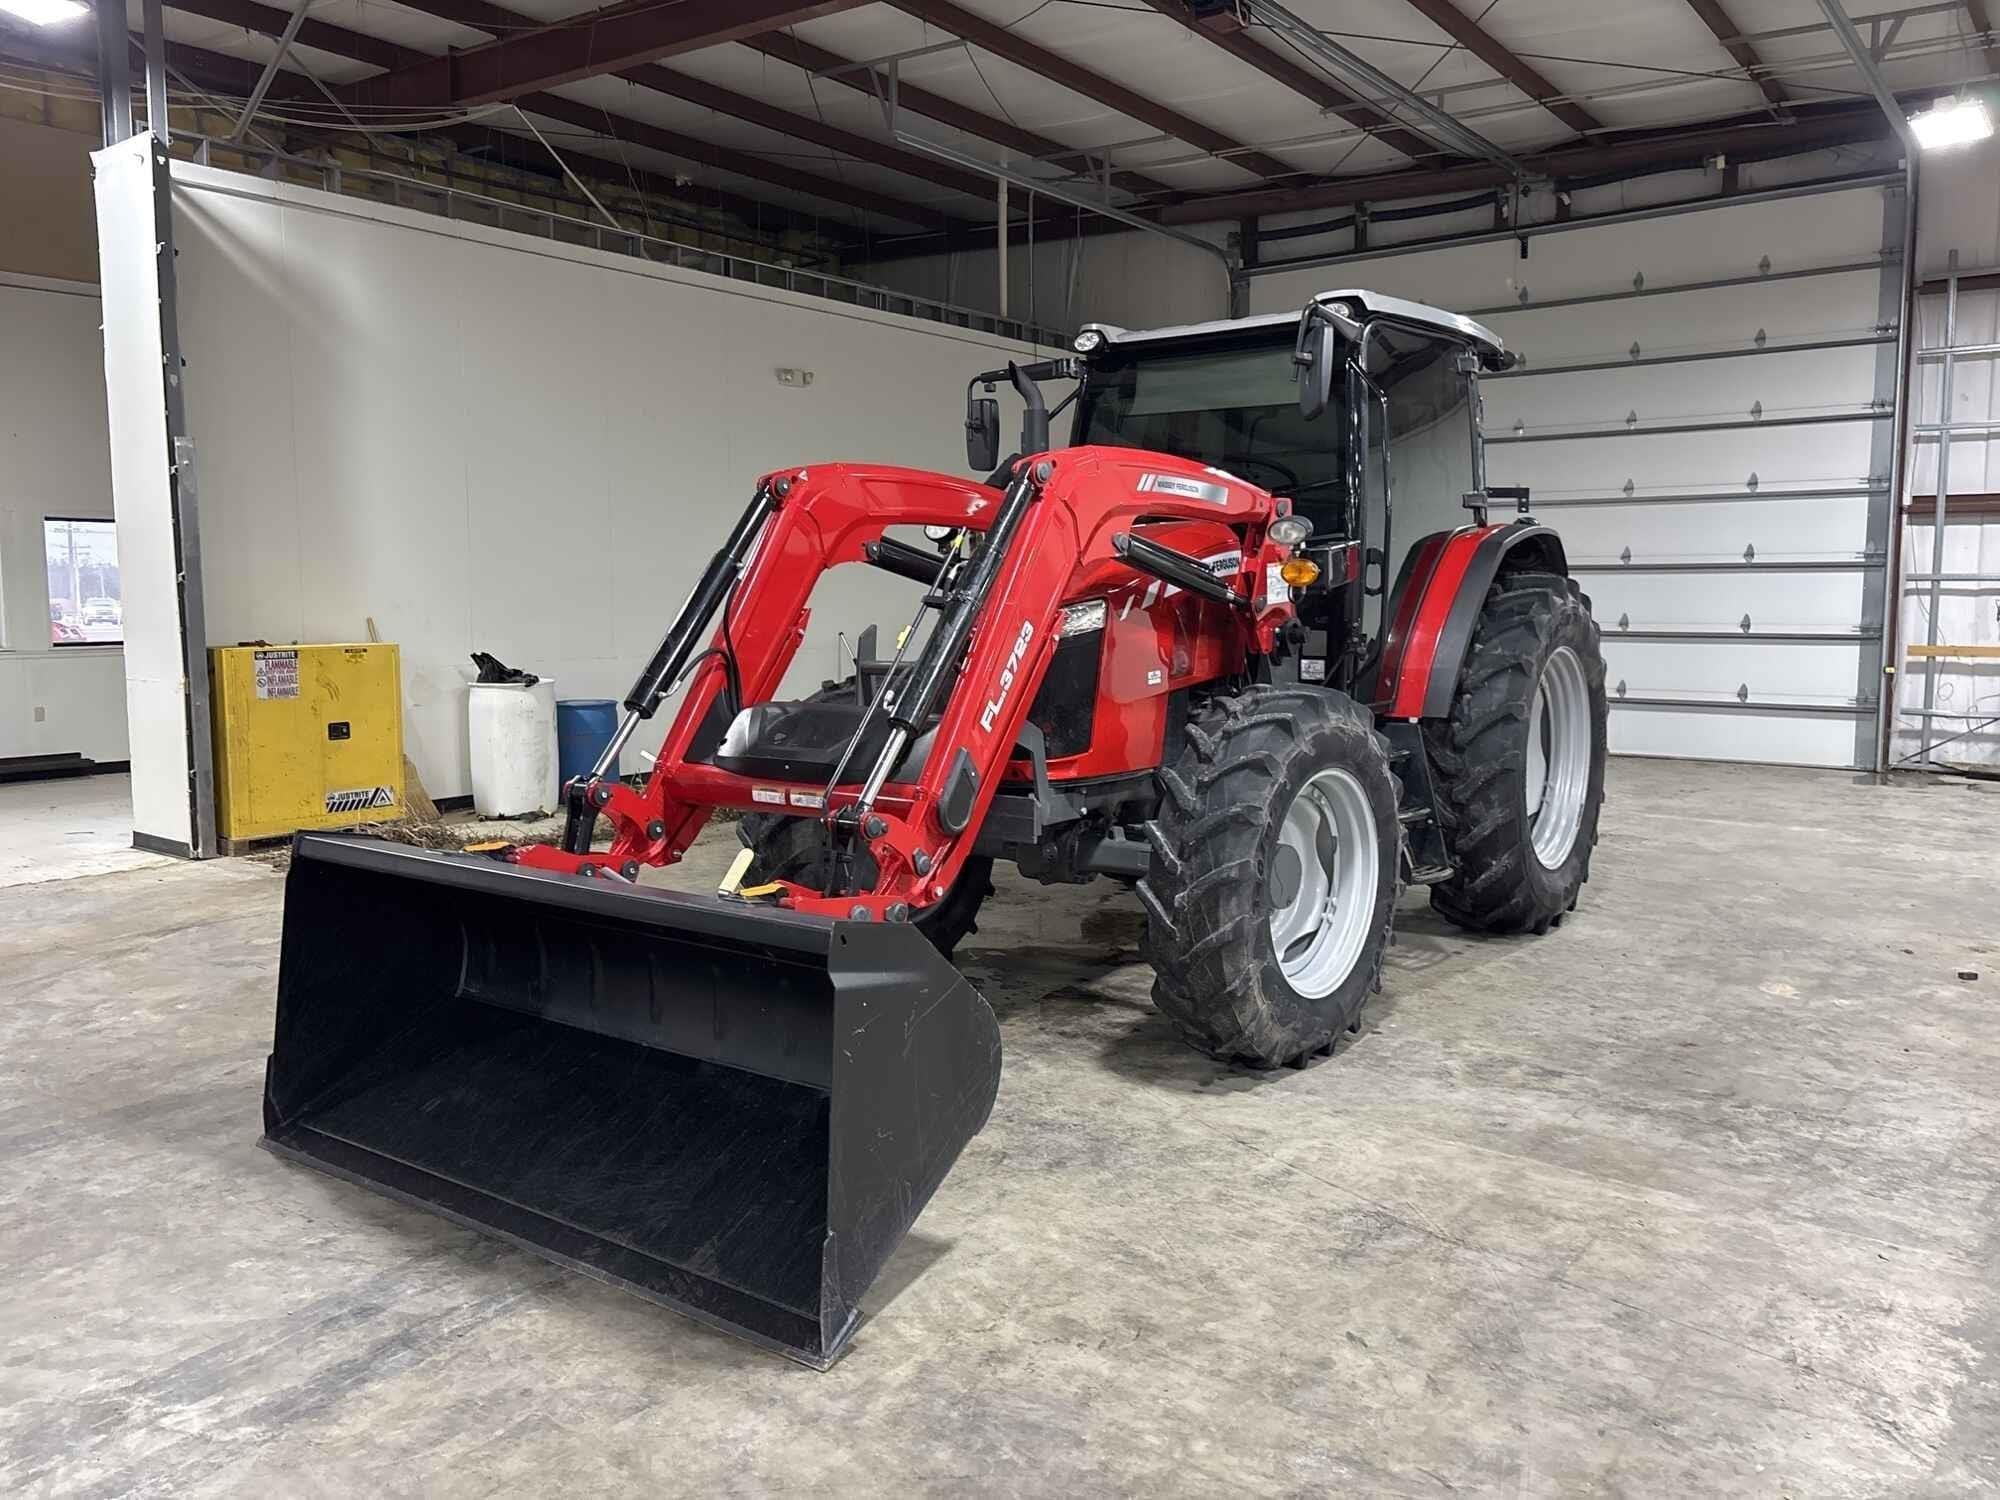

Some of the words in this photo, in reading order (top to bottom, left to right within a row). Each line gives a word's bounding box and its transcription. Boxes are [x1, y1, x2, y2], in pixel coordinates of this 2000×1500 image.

[1212, 557, 1240, 572] FERGUSON
[264, 651, 295, 659] JUSTRITE
[265, 660, 297, 670] FLAMMABLE
[980, 620, 1034, 733] FL.3723
[336, 791, 369, 800] JUSTRITE
